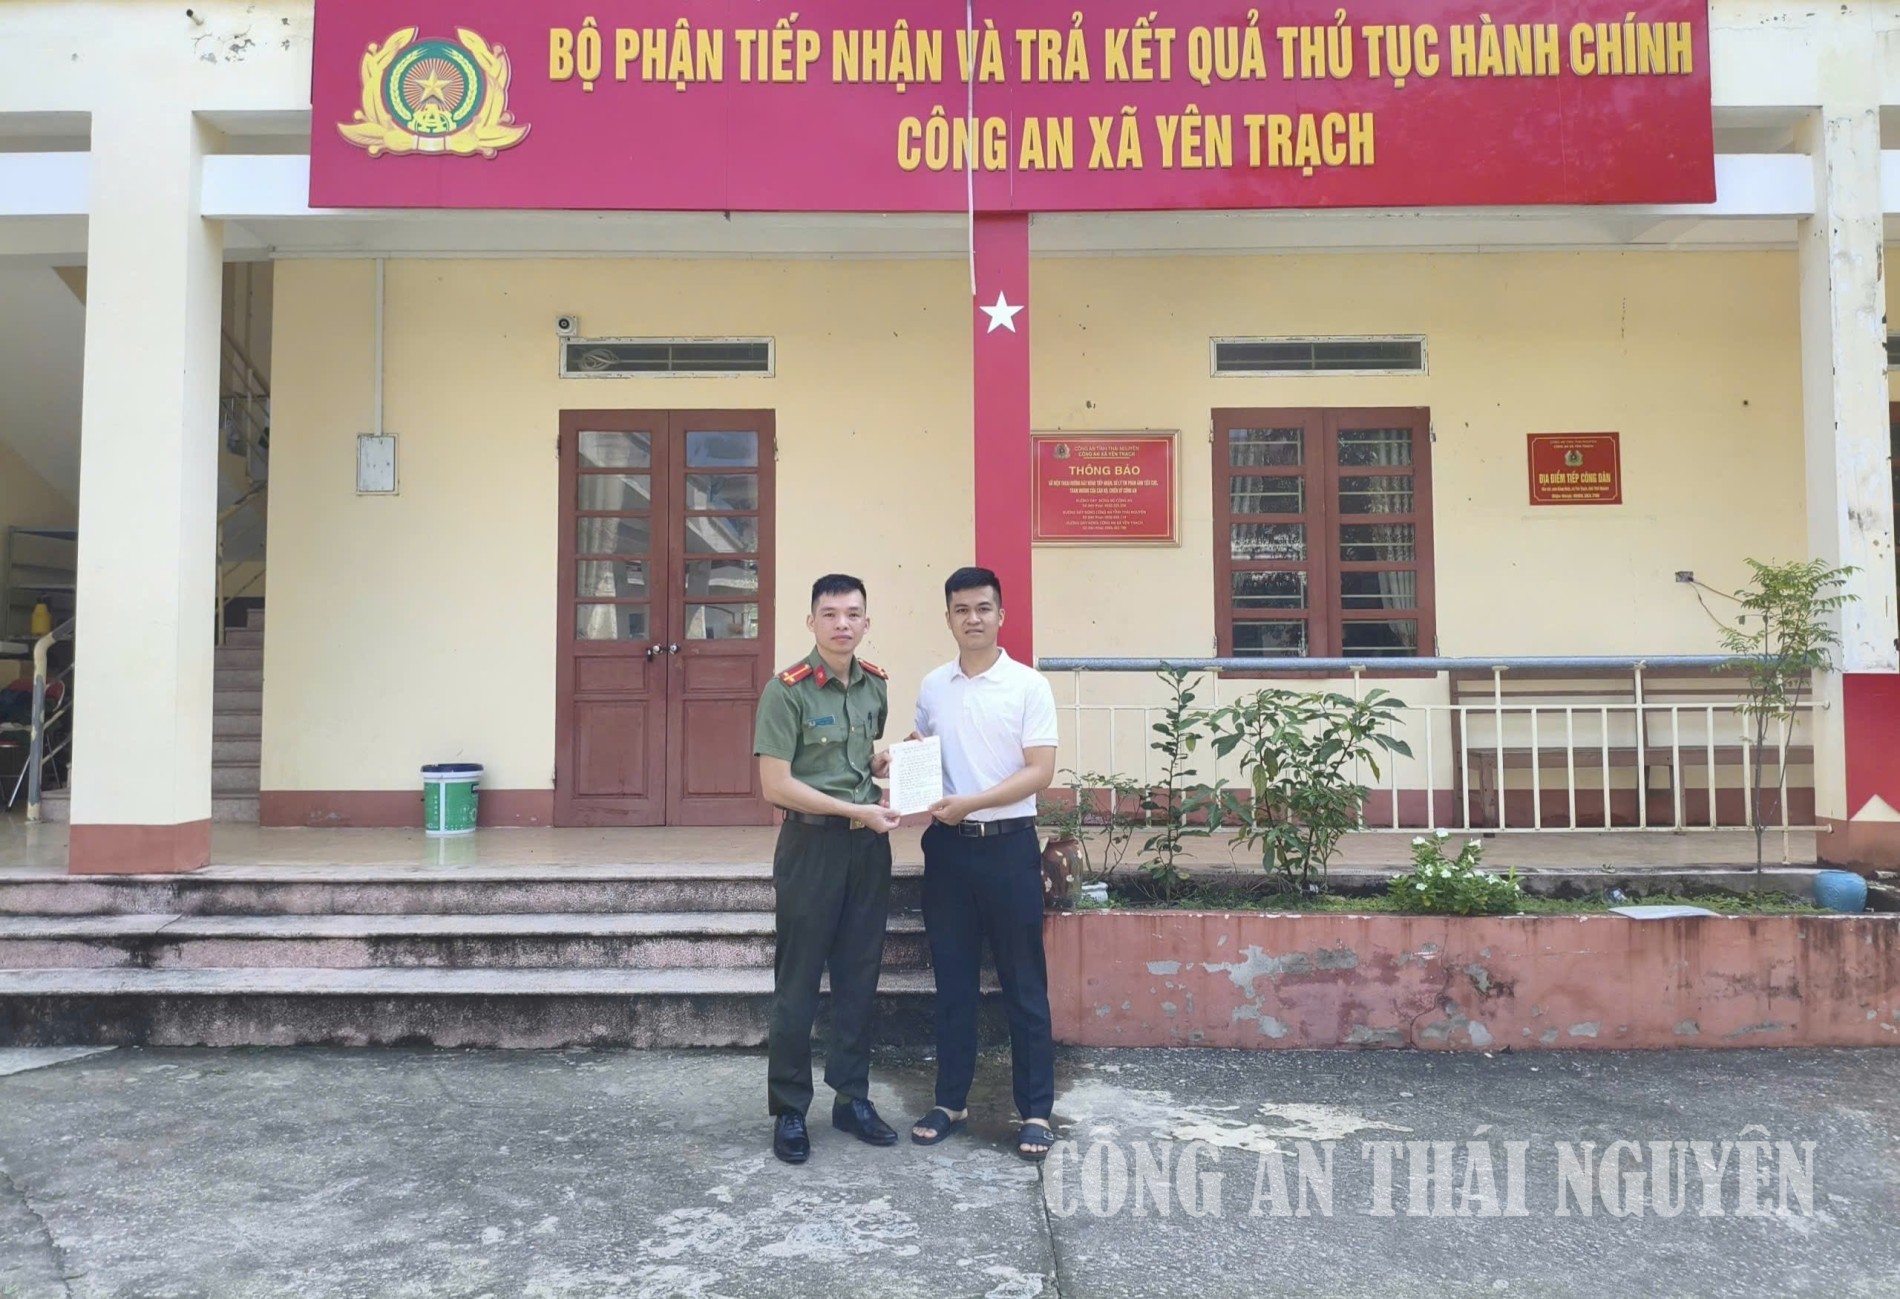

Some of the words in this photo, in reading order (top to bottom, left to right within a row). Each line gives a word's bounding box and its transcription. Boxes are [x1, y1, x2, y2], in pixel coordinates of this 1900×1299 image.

[548, 16, 602, 92] BỘ
[615, 17, 724, 92] PHẬN
[735, 12, 821, 83] TIẾP
[832, 18, 943, 93] NHẬN
[955, 18, 1006, 84] VÀ
[1015, 11, 1090, 83] TRẢ
[1104, 12, 1176, 82] KẾT
[1187, 8, 1267, 87] QUẢ
[1276, 8, 1353, 79] THỦ
[1361, 22, 1440, 89] TỤC
[1450, 14, 1560, 78] HÀNH
[1569, 11, 1694, 76] CHÍNH
[897, 105, 1007, 171] CÔNG
[1018, 116, 1074, 170] AN
[1087, 105, 1144, 170] XÃ
[1155, 103, 1233, 169] YÊN
[1243, 111, 1376, 177] TRẠCH
[1068, 464, 1111, 476] THÔNG
[1114, 464, 1141, 476] BÁO
